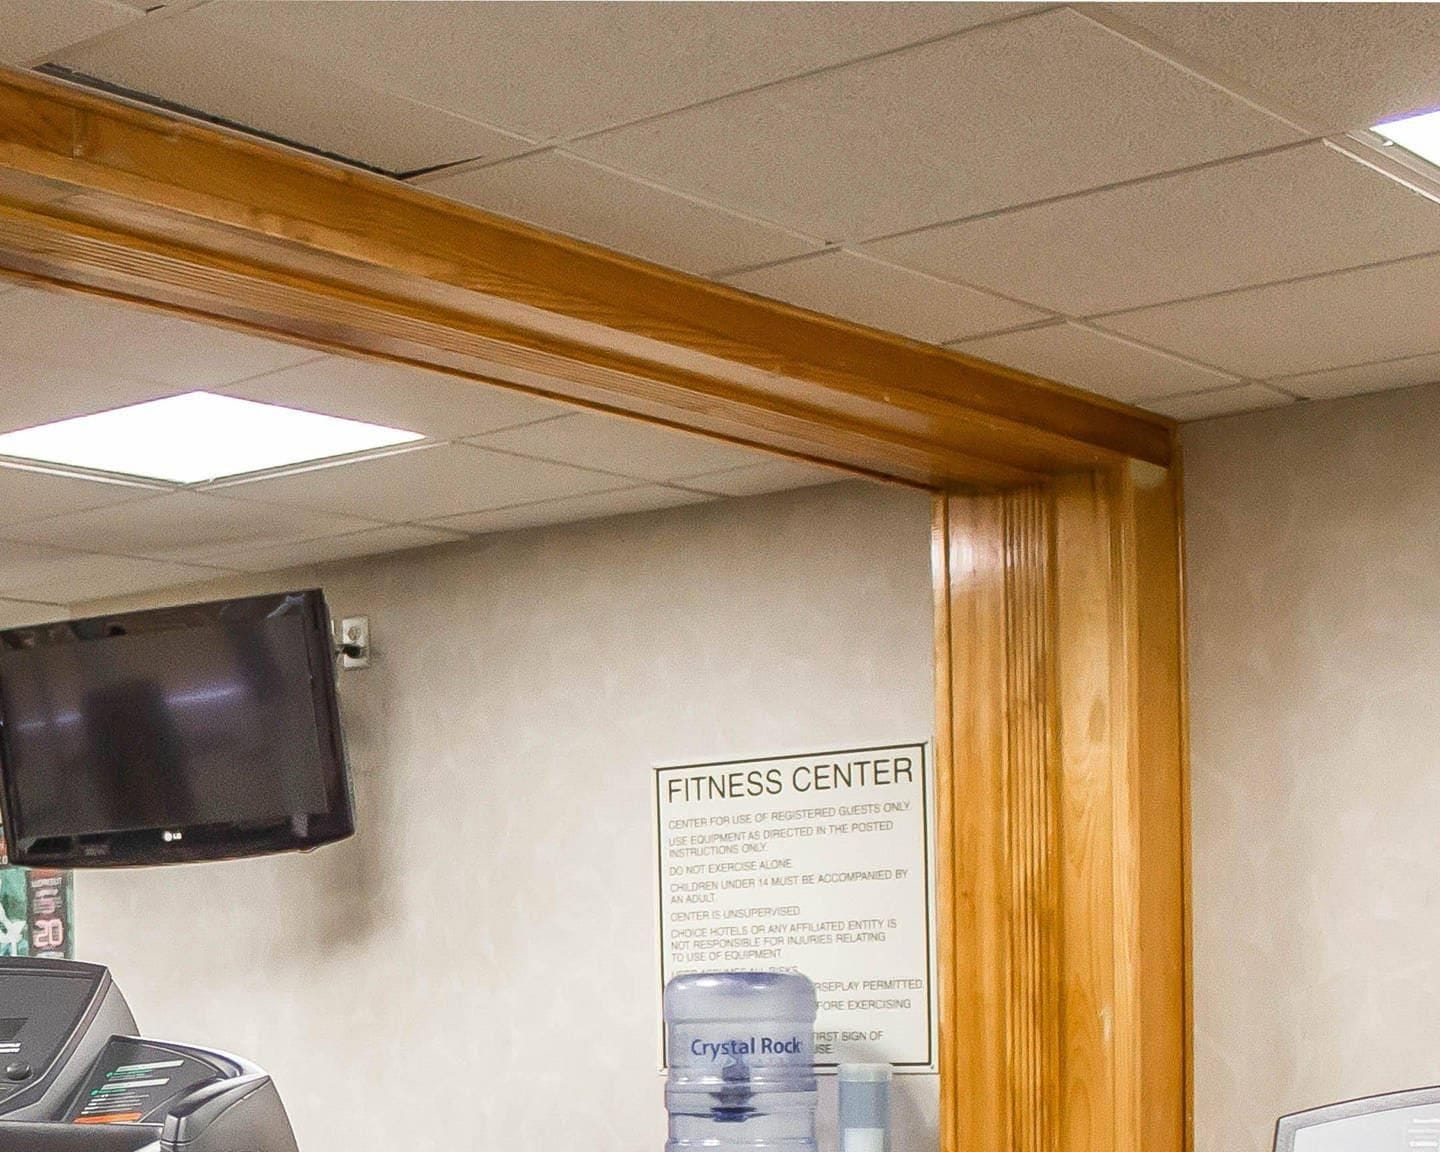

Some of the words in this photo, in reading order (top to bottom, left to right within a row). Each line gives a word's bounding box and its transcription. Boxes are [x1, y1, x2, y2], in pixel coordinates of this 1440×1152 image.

[668, 768, 783, 803] FITNESS
[792, 757, 913, 793] CENTER
[668, 818, 708, 830] CENTER
[710, 816, 730, 827] FOR
[732, 814, 752, 825] USE
[754, 812, 769, 823] OF
[771, 807, 836, 821] REGISTERED
[838, 803, 881, 816] GUESTS
[883, 801, 911, 813] ONLY
[668, 836, 688, 847] USE
[690, 832, 746, 845] EQUIPMENT
[748, 830, 761, 840] AS
[763, 827, 814, 840] DIRECTED
[816, 825, 826, 835] IN
[829, 824, 849, 834] THE
[851, 820, 894, 833] POSTED
[669, 844, 739, 858] INSTRUCTIONS
[669, 866, 684, 876] DO
[686, 864, 706, 875] NOT
[708, 860, 757, 873] EXERCISE
[759, 858, 793, 870] ALONE
[670, 880, 718, 893] CHILDREN
[720, 878, 755, 890] UNDER
[759, 877, 769, 887] 14
[770, 875, 800, 887] MUST
[802, 874, 815, 885] BE
[817, 869, 893, 884] ACCOMPANIED
[895, 868, 909, 879] BY
[670, 895, 684, 904] AN
[686, 892, 715, 904] ADULT
[670, 910, 709, 922] CENTER
[711, 909, 721, 920] IS
[723, 905, 801, 920] UNSUPERVISED
[670, 927, 708, 939] CHOICE
[709, 925, 748, 937] HOTELS
[750, 924, 765, 935] OR
[768, 923, 788, 934] ANY
[790, 920, 846, 933] AFFILIATED
[847, 919, 885, 931] ENTITY
[887, 918, 898, 929] IS
[670, 940, 691, 951] NOT
[693, 937, 761, 950] RESPONSIBLE
[763, 936, 785, 947] FOR
[787, 934, 833, 945] INJURIES
[835, 931, 887, 944] RELATING
[671, 952, 685, 963] TO
[686, 951, 705, 962] USE
[708, 951, 723, 961] OF
[724, 948, 782, 961] EQUIPMENT
[815, 981, 860, 992] RSEPLAY
[862, 978, 923, 991] PERMITTED
[816, 1000, 845, 1011] FORE
[847, 998, 912, 1010] EXERCISING
[841, 1030, 867, 1041] SIGN
[869, 1030, 884, 1041] OF
[690, 1036, 756, 1063] Crystal
[761, 1034, 801, 1055] Rock
